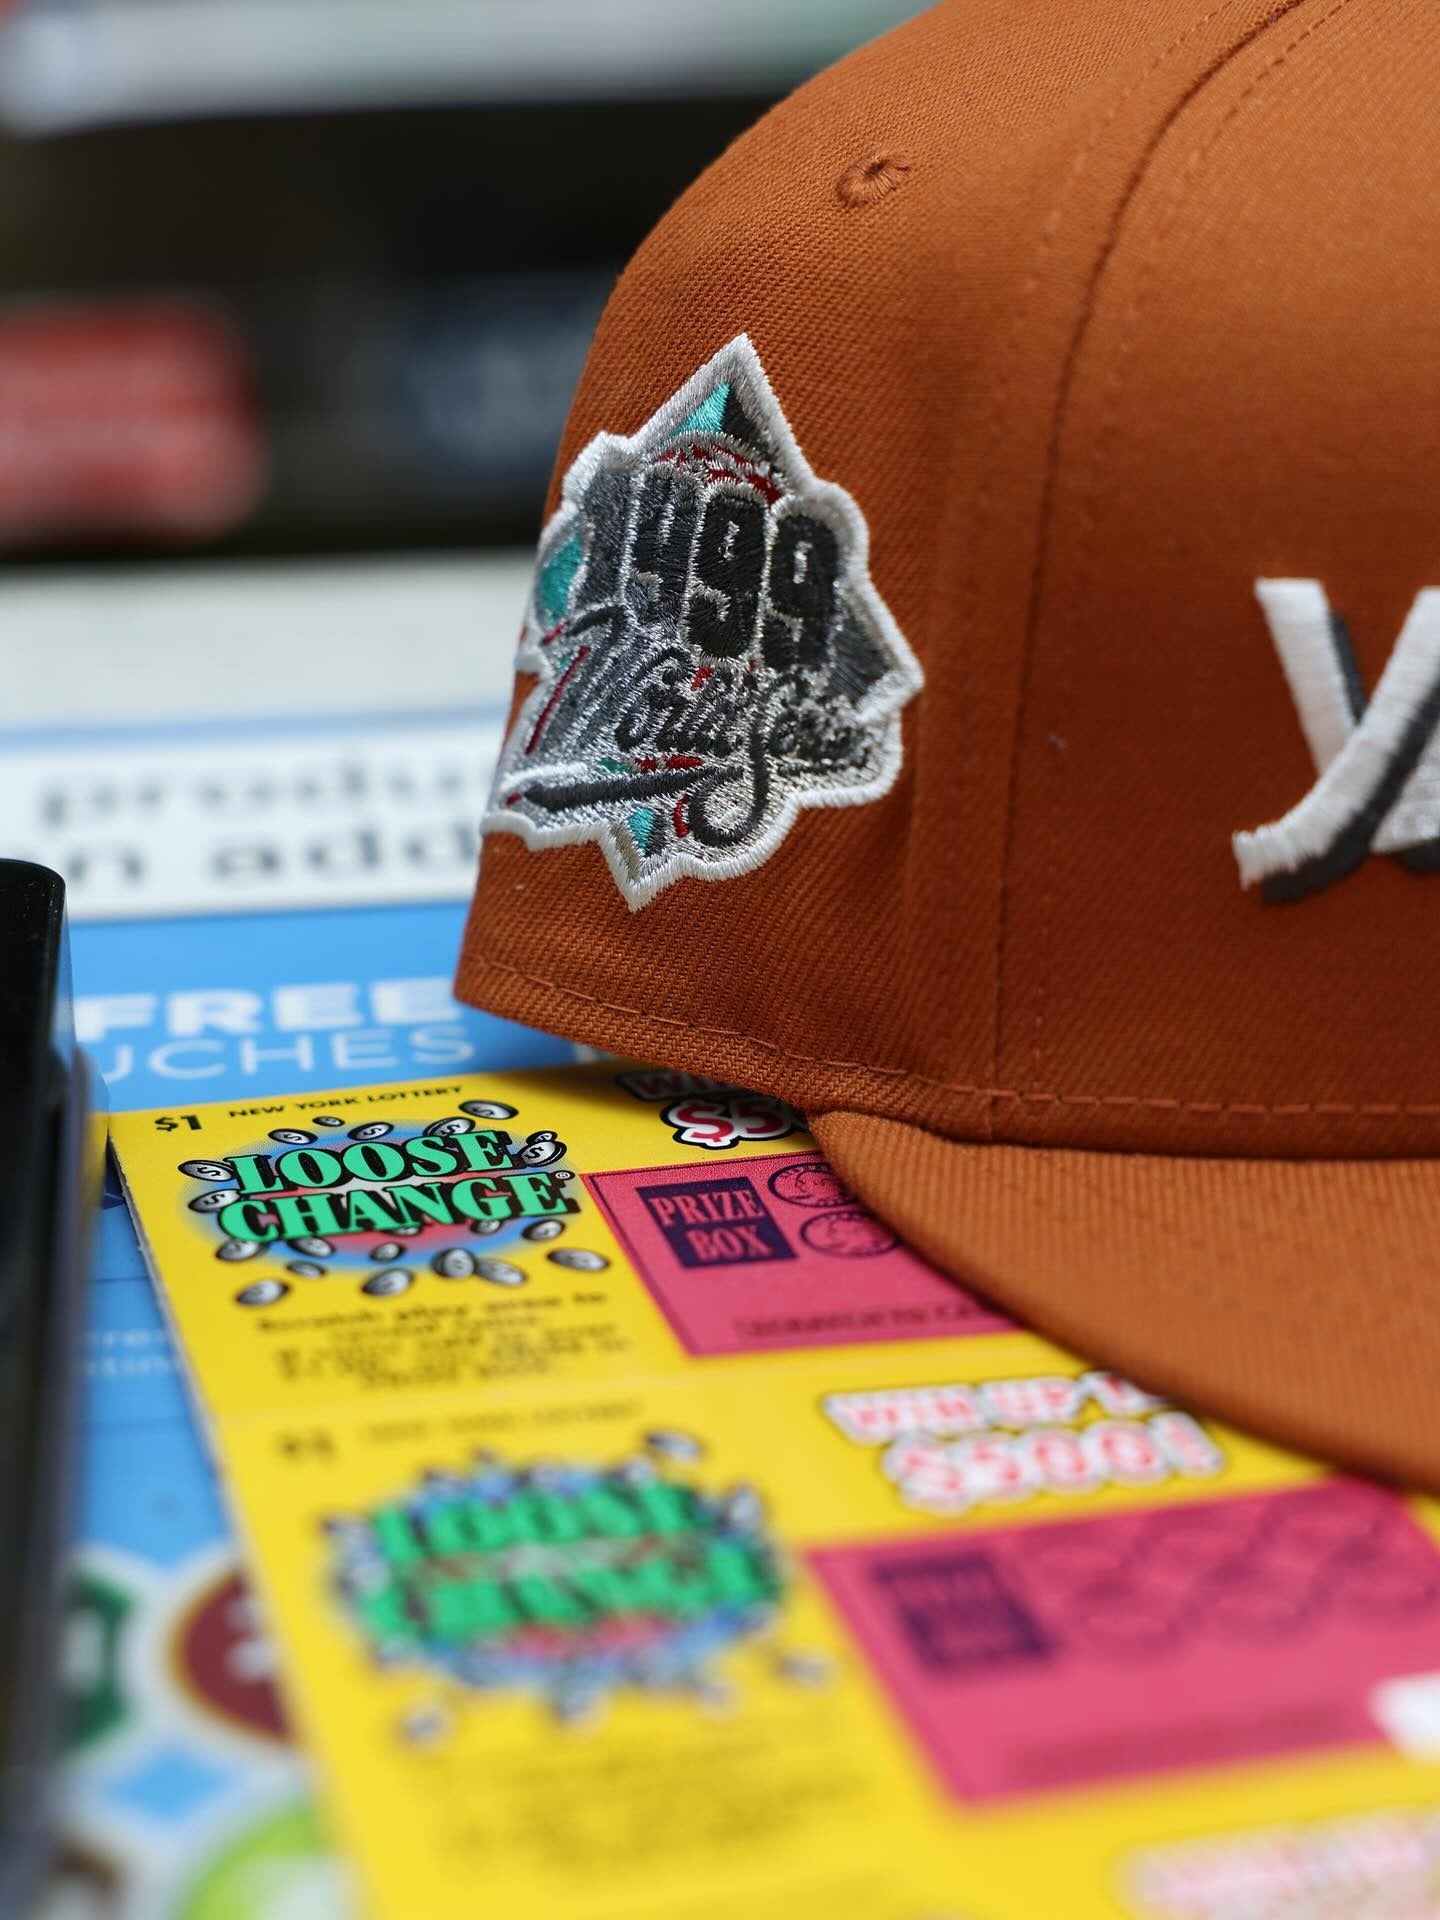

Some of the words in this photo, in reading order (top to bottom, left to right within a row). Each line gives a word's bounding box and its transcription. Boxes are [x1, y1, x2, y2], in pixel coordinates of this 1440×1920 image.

[577, 466, 839, 672] 1999
[38, 755, 495, 834] produ
[76, 976, 464, 1042] FREE
[154, 1113, 203, 1133] $1
[227, 1104, 285, 1118] NEW
[295, 1097, 361, 1111] YORK
[367, 1085, 464, 1103] LOTTERY
[228, 1129, 520, 1196] LOOSE
[648, 1189, 765, 1228] PRIZE
[687, 1225, 774, 1262] BOX
